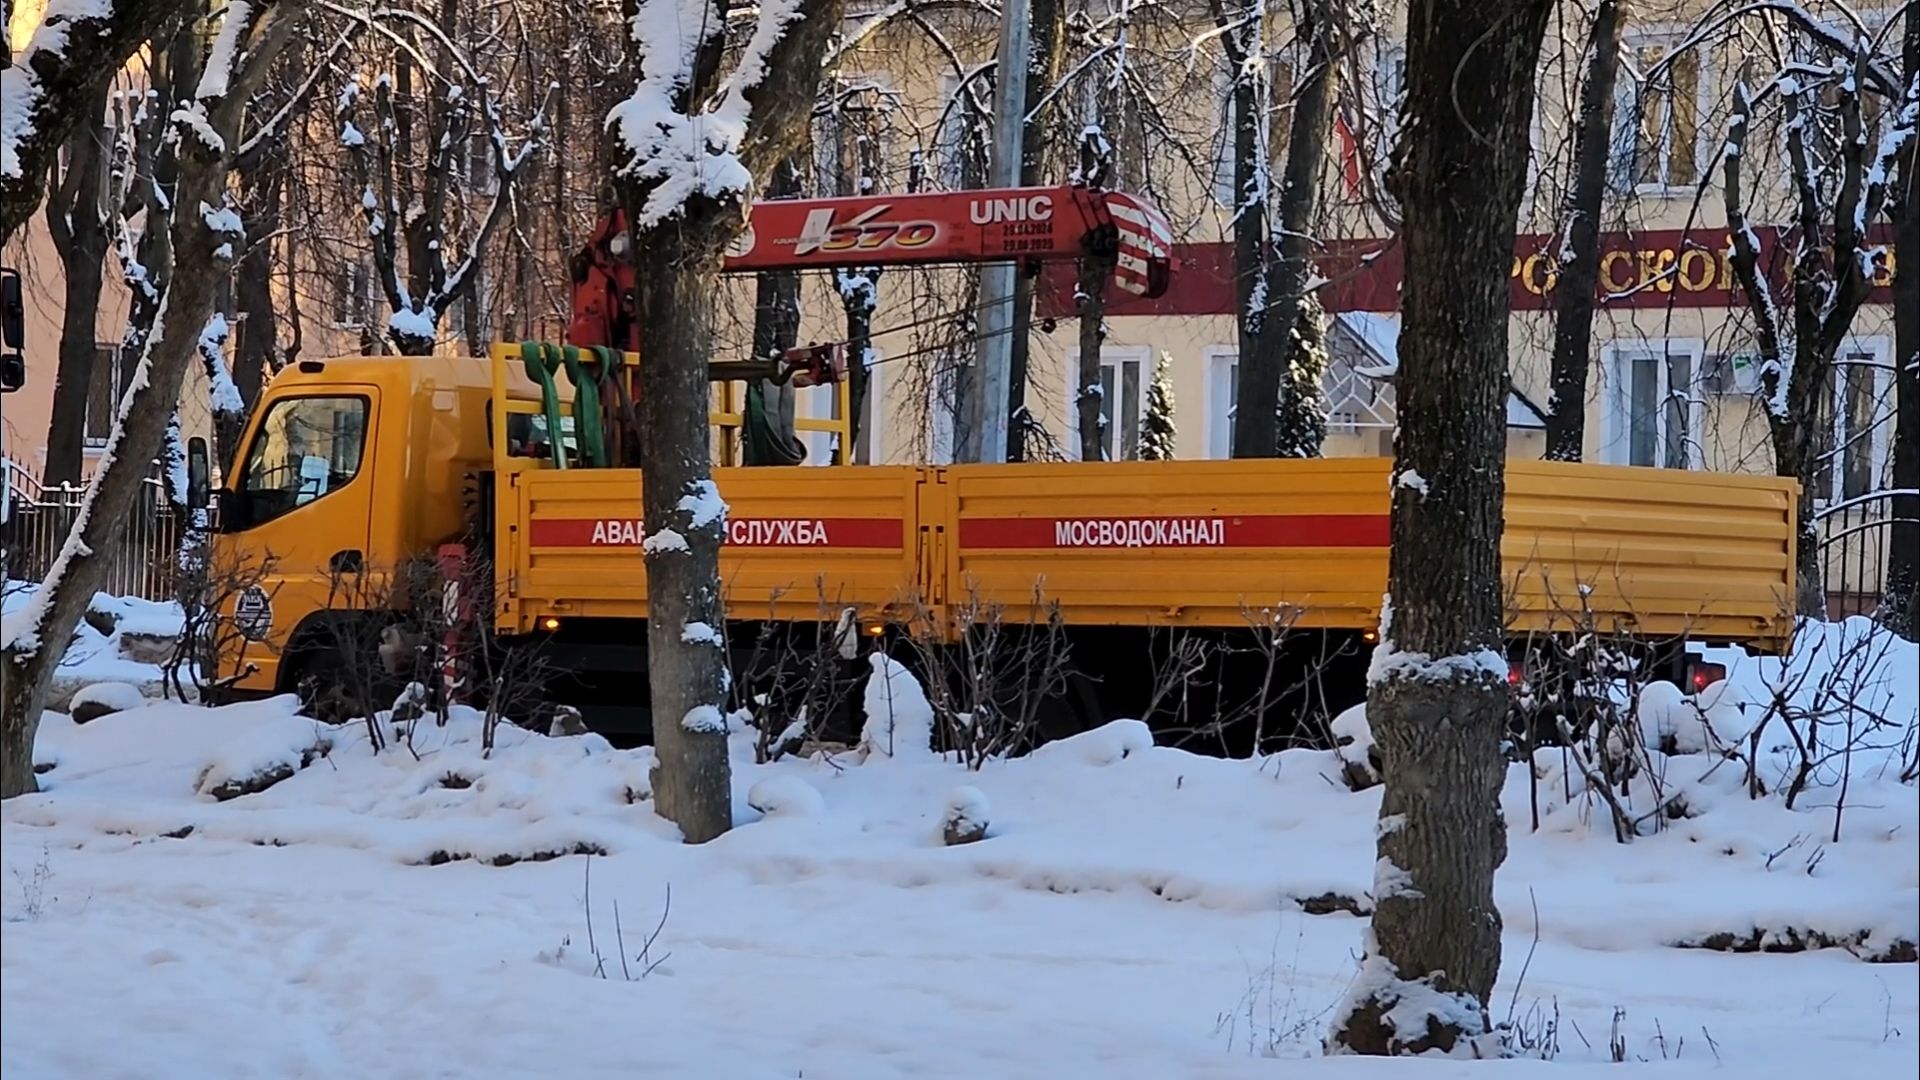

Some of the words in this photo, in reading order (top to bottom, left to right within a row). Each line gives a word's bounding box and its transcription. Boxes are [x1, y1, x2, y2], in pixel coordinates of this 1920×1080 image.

[970, 195, 1053, 224] UNIC
[732, 520, 828, 544] СЛУЖБА
[1055, 519, 1225, 548] МОСВОДОКАНАЛ
